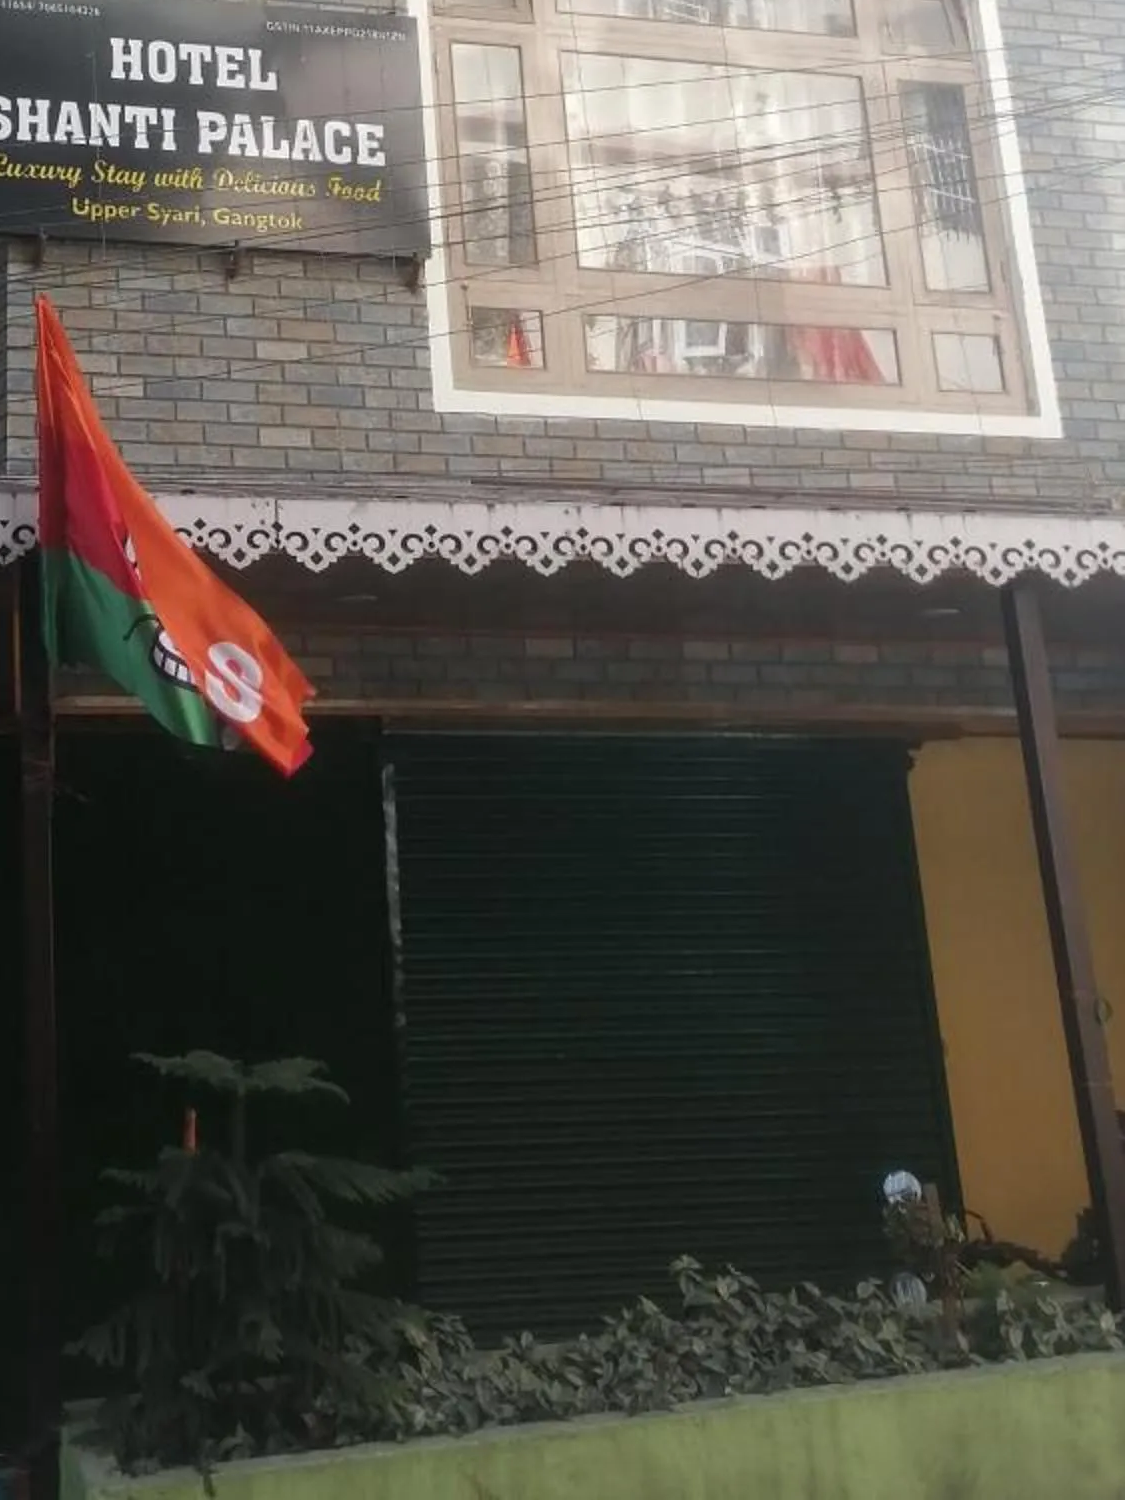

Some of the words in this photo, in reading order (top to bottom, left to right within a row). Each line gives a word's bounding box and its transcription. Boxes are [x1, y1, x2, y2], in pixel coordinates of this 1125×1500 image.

[110, 37, 278, 92] HOTEL
[196, 109, 387, 167] PALACE
[91, 160, 147, 191] Stay
[154, 166, 204, 190] with
[212, 167, 316, 198] Delicious
[325, 176, 383, 203] Food
[71, 197, 141, 222] Upper
[147, 202, 207, 228] Syari,
[213, 207, 303, 233] Gangtok
